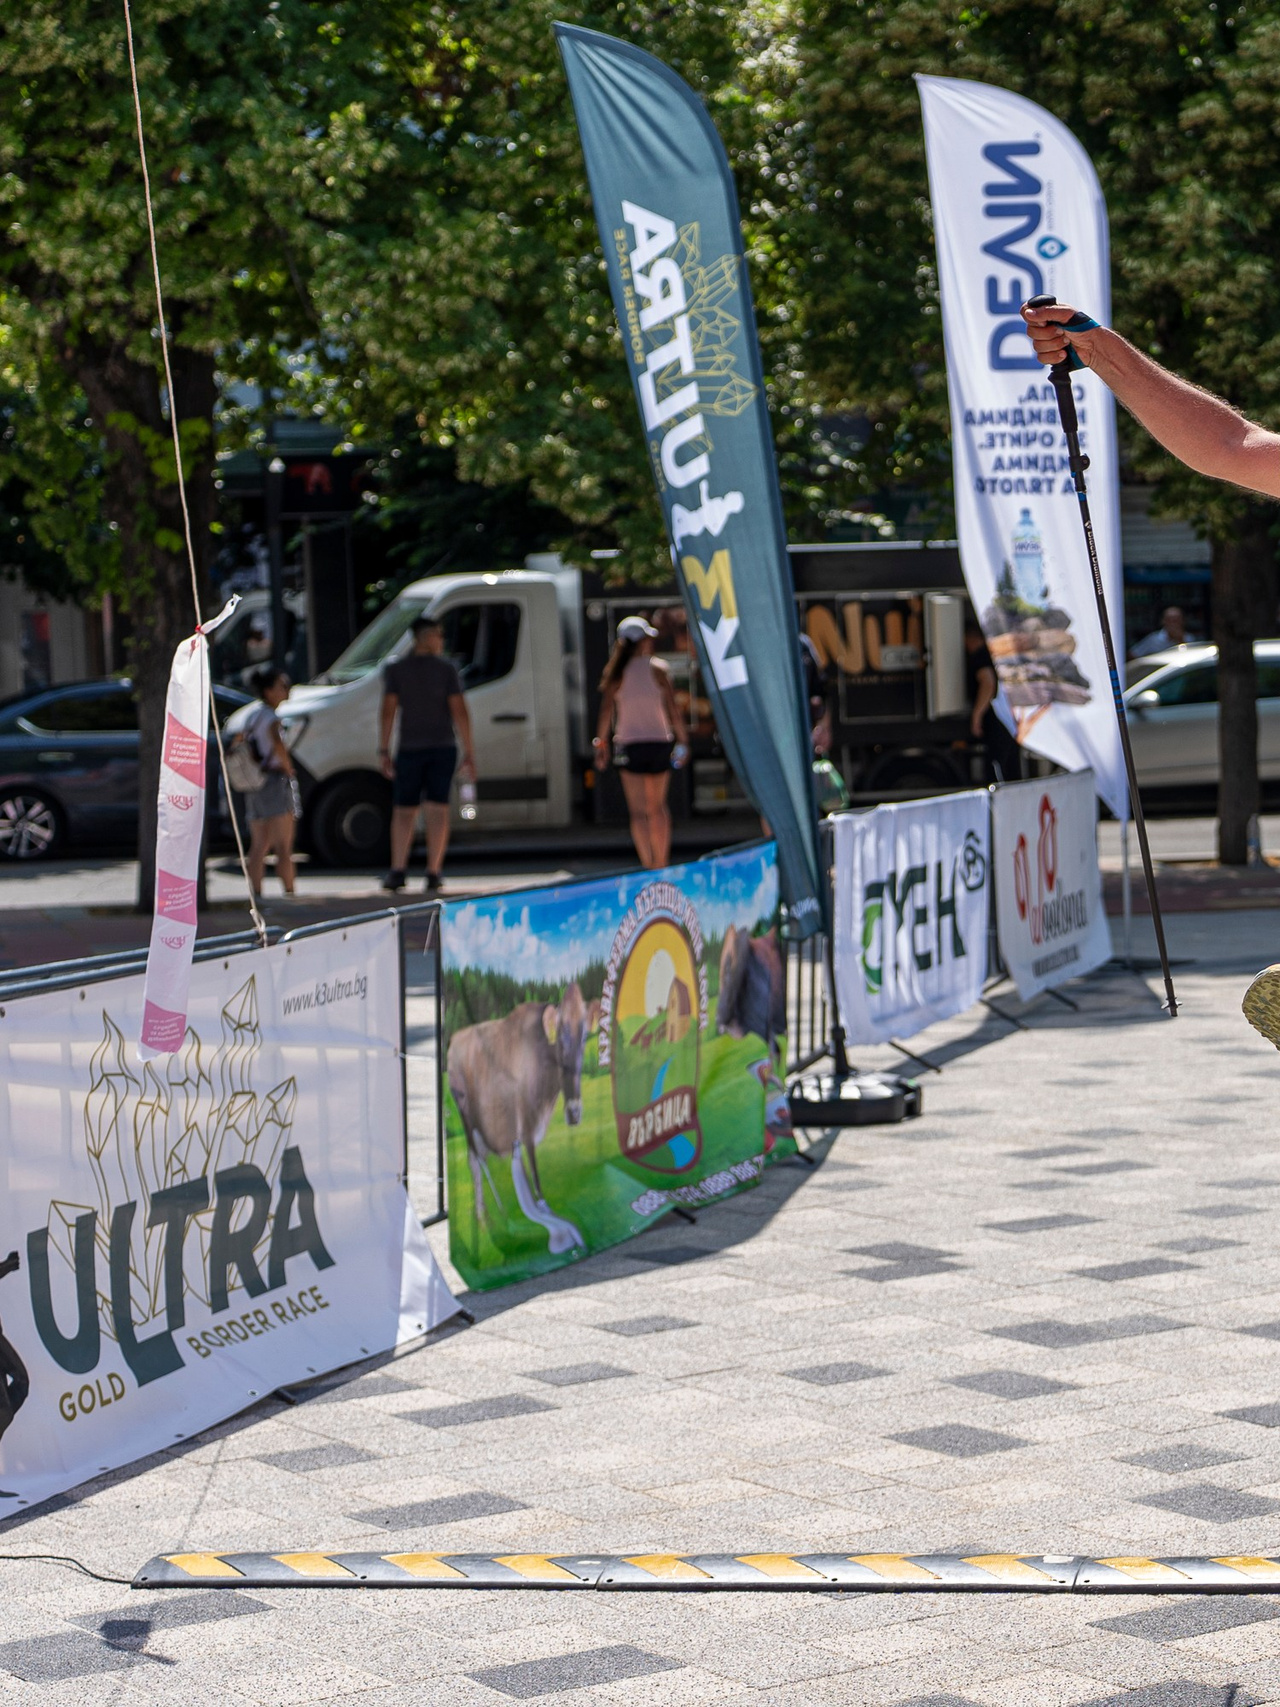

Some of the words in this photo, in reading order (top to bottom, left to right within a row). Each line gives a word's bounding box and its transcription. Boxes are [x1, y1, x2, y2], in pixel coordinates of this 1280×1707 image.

[283, 972, 368, 1016] www.k3ultra.bg
[627, 1093, 692, 1149] ВЪРБИЦА
[26, 1146, 336, 1388] ULTRA
[58, 1371, 127, 1423] GOLD
[186, 1307, 270, 1360] BORDER
[270, 1284, 331, 1329] RACE
